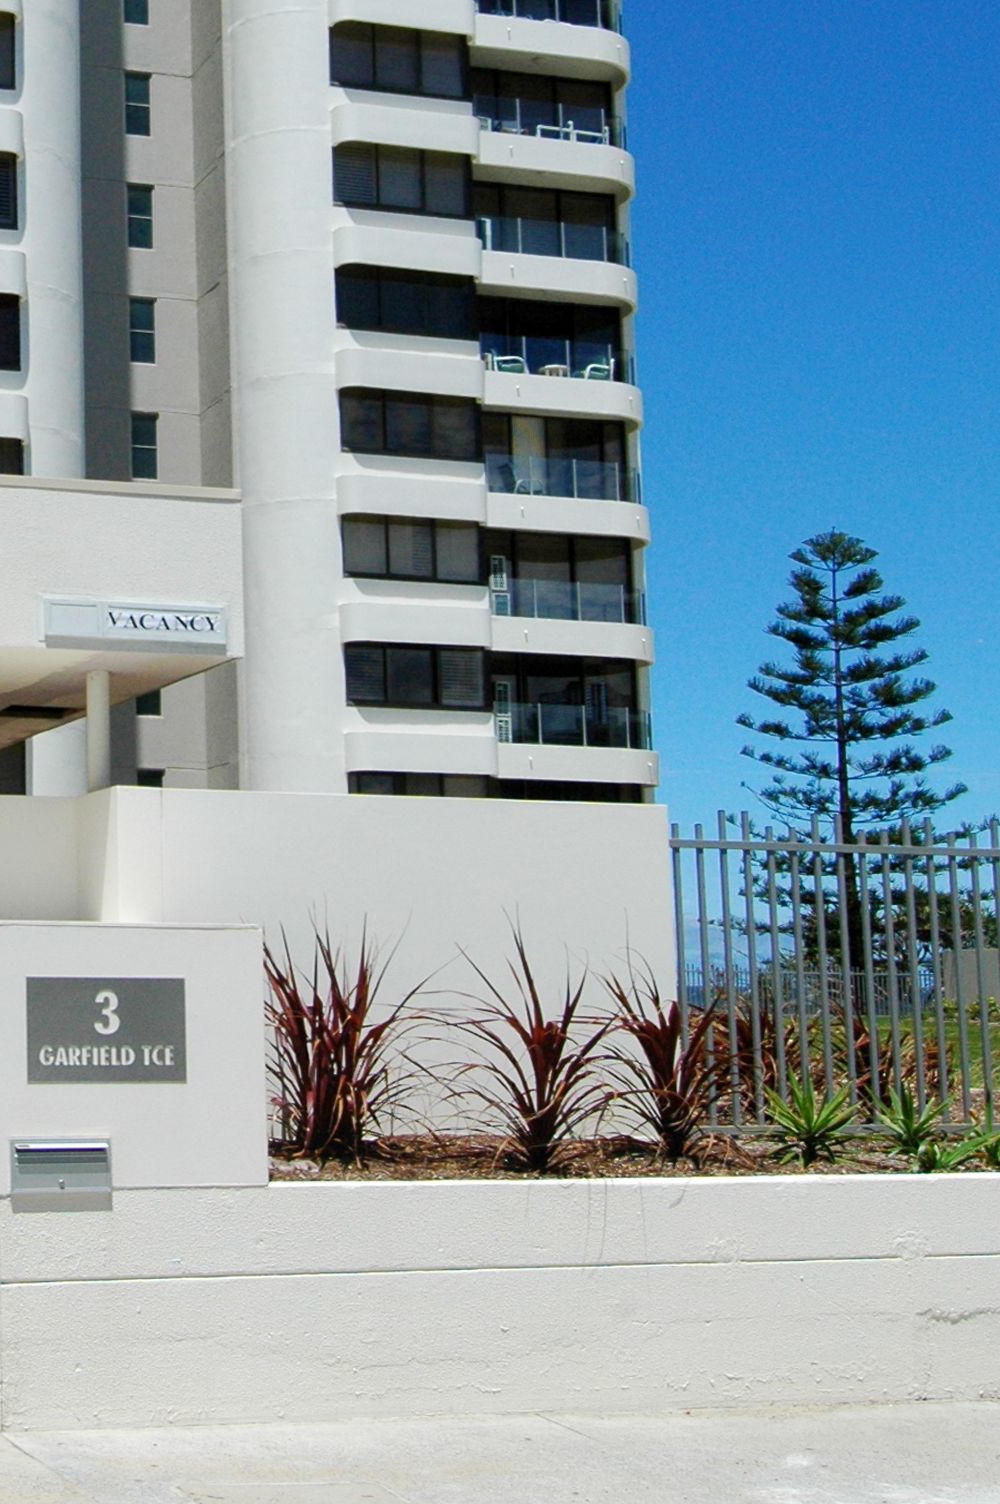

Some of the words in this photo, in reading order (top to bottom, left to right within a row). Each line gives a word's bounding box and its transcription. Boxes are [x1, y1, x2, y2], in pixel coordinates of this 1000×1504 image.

[108, 611, 219, 632] VACANCY
[93, 991, 121, 1035] 3
[39, 1046, 136, 1066] GARFIELD
[141, 1046, 175, 1066] TCE
